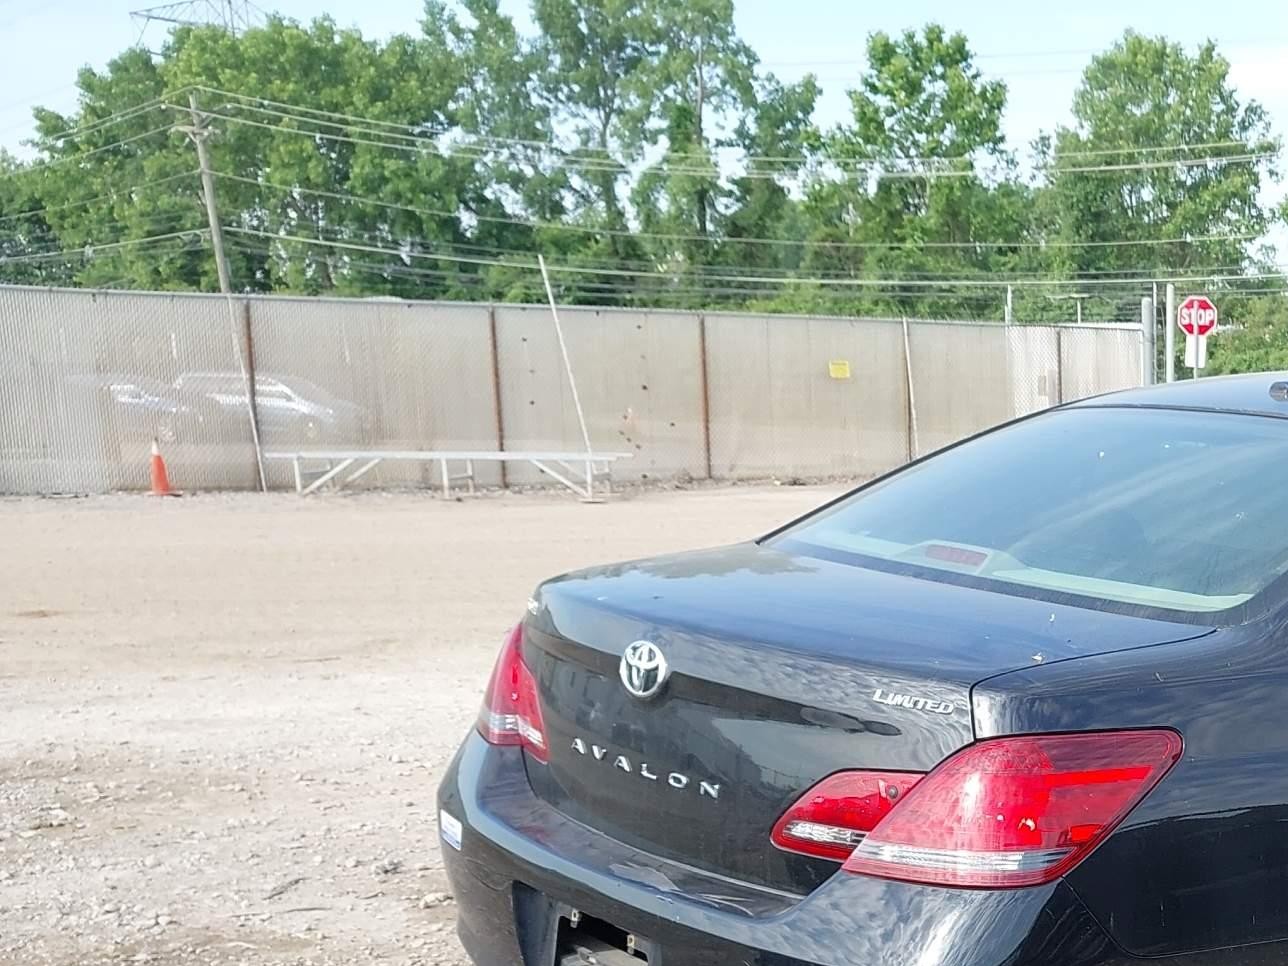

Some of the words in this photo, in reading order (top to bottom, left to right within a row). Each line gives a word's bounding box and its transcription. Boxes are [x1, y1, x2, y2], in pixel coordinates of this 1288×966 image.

[1180, 308, 1214, 326] STOP
[872, 688, 955, 715] LIMITED
[570, 736, 722, 800] AVALON
